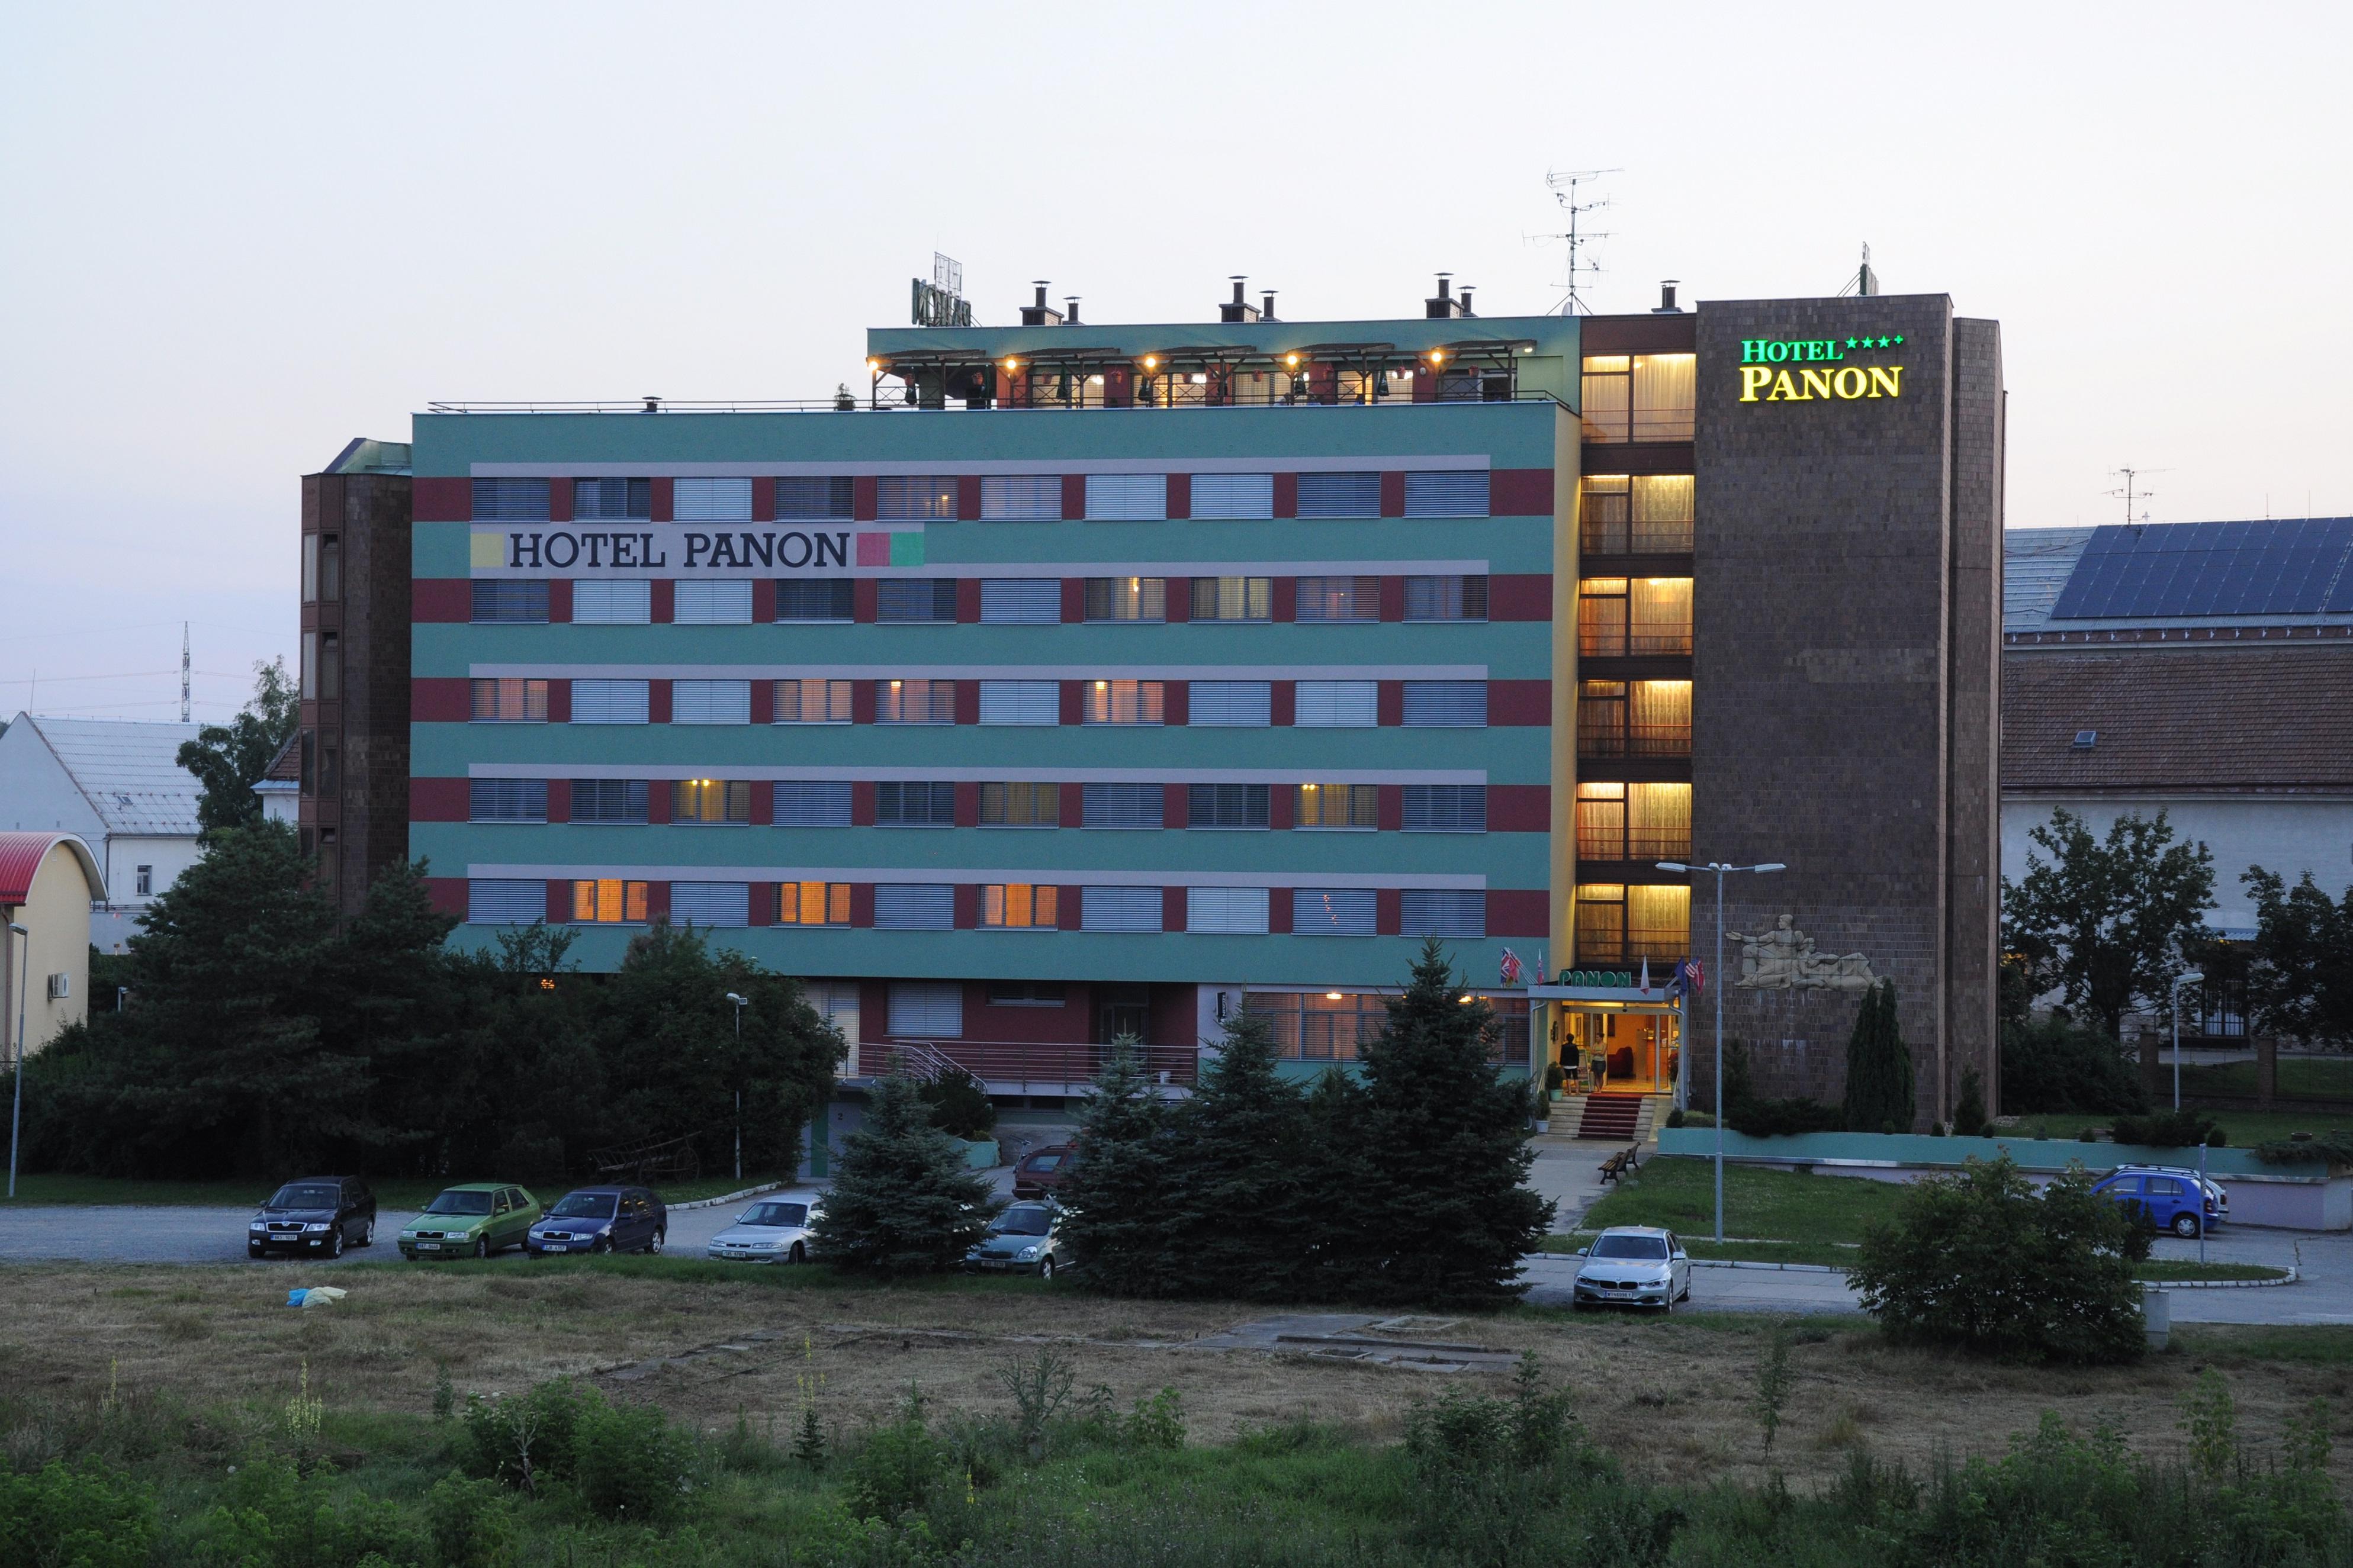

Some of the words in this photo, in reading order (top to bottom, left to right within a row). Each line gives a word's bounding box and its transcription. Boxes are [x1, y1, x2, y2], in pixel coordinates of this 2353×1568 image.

[1741, 339, 1843, 362] HOTEL
[1739, 366, 1904, 402] PANON
[510, 532, 666, 568] HOTEL
[683, 532, 850, 568] PANON
[1558, 970, 1632, 988] PANON
